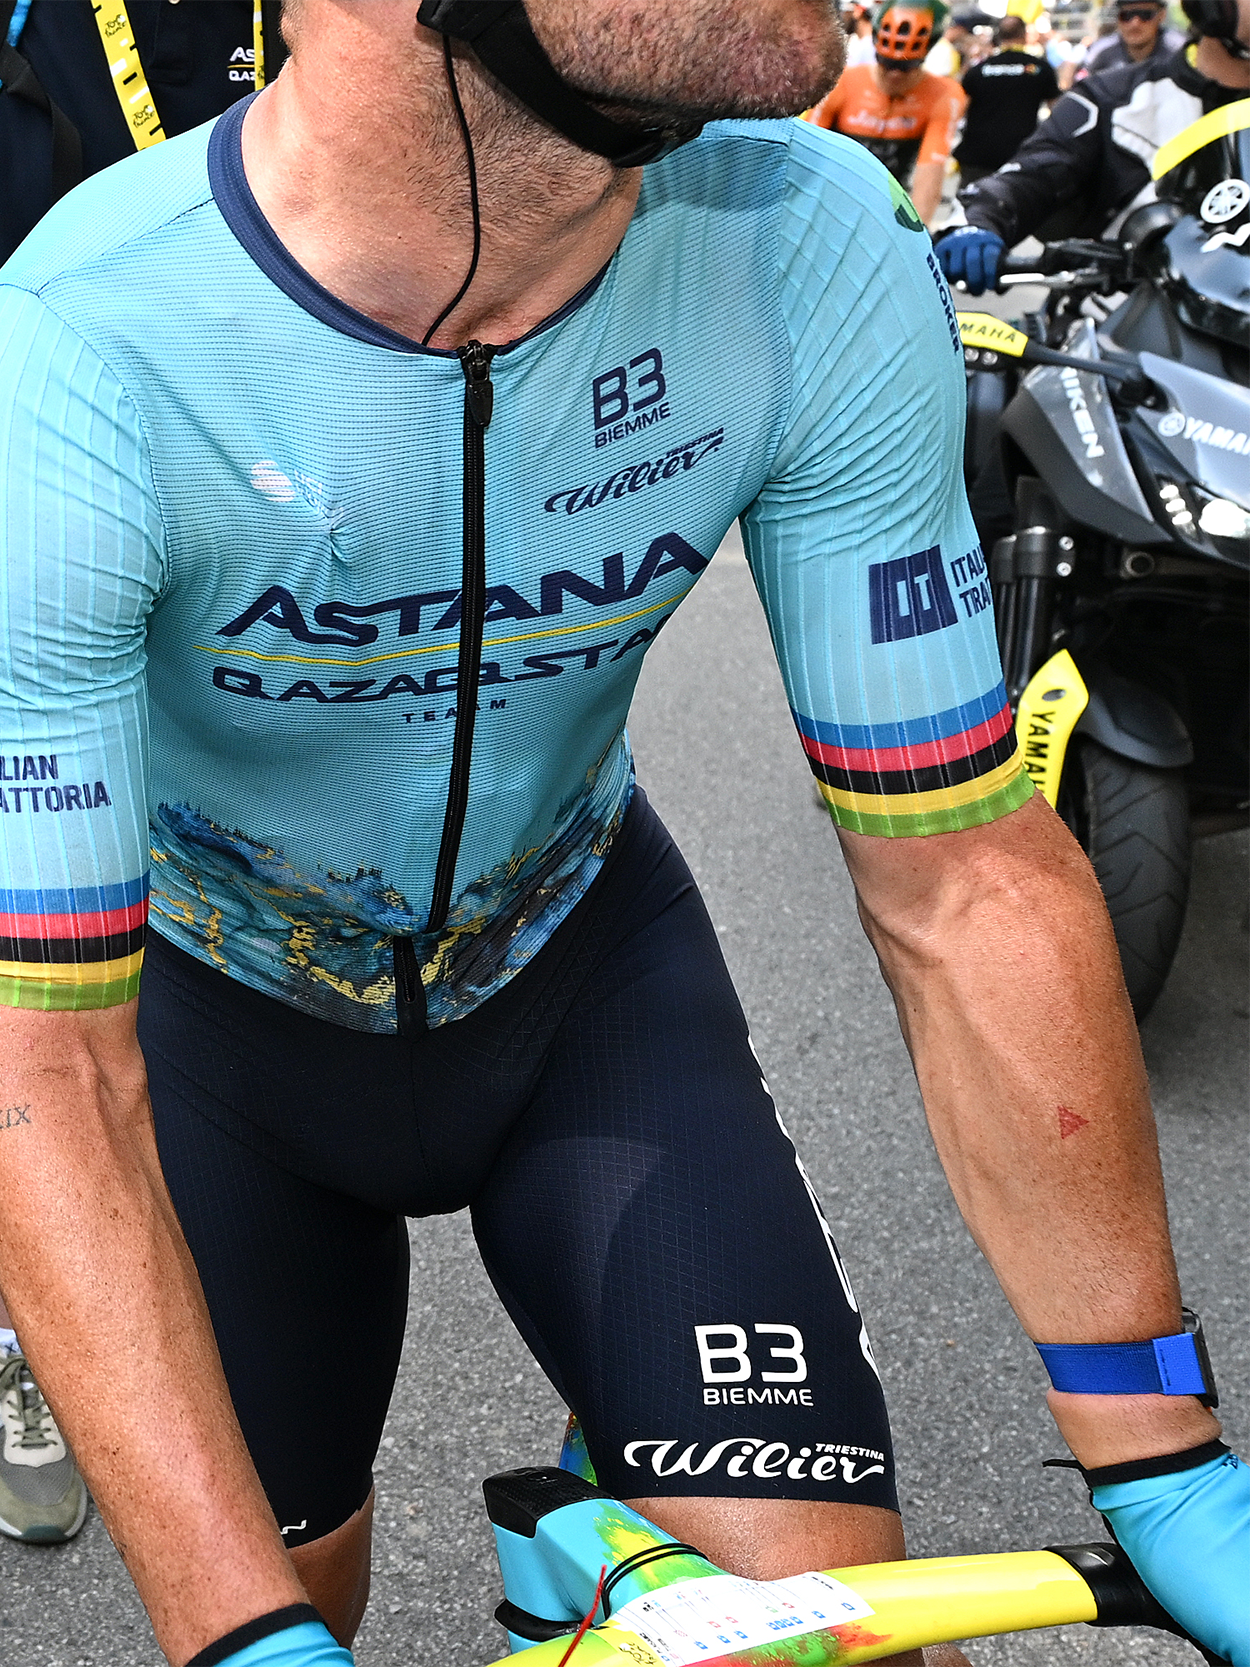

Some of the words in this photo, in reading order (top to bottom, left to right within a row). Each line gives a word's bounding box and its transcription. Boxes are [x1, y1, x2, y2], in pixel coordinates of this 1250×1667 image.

[959, 322, 1017, 344] MAHA
[592, 347, 666, 430] B3
[595, 402, 671, 448] BIEMME
[1183, 416, 1250, 456] YAMA
[544, 436, 725, 516] Wilier
[215, 531, 710, 648] ASTANA
[212, 613, 677, 704] QAZAQSTA
[1025, 711, 1056, 794] YAMA
[694, 1323, 808, 1384] B3
[703, 1388, 814, 1407] BIEMME
[623, 1437, 885, 1484] Wilier
[815, 1442, 885, 1463] TRIESTINA
